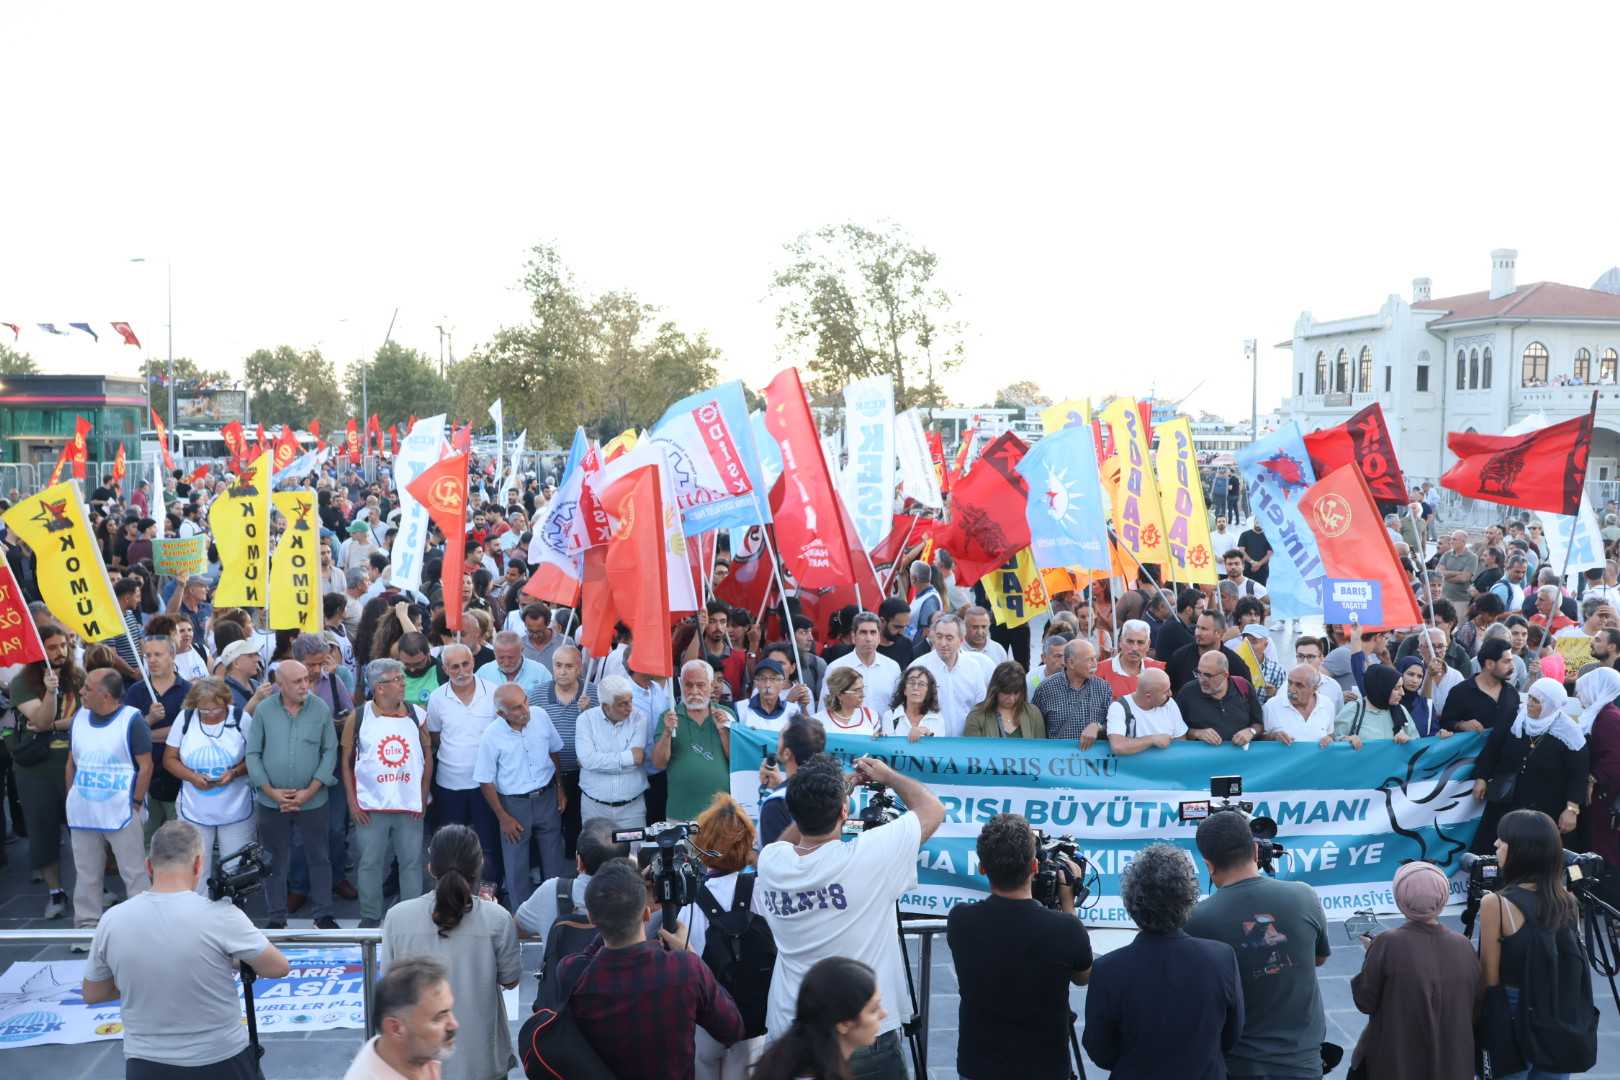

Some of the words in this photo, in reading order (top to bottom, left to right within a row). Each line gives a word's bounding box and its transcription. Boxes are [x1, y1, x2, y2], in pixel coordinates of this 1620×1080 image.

[1340, 586, 1367, 598] BARIŞ
[1342, 601, 1368, 610] YAŞATIR
[875, 750, 959, 775] DÜNYA
[966, 756, 1042, 781] BARIŞ
[1048, 753, 1119, 777] GÜNÜ
[73, 770, 129, 790] KESK
[1024, 796, 1198, 827] BÜYÜTM
[1252, 798, 1371, 826] AMANI
[1349, 842, 1385, 866] YE
[899, 893, 938, 909] ARIŞ
[942, 896, 963, 909] VE
[1078, 908, 1135, 922] ÜÇLER
[1319, 889, 1394, 910] OKRASÎYÊ
[287, 965, 347, 979] ARIŞ
[244, 1003, 324, 1012] UBELER
[328, 1000, 363, 1009] PLA
